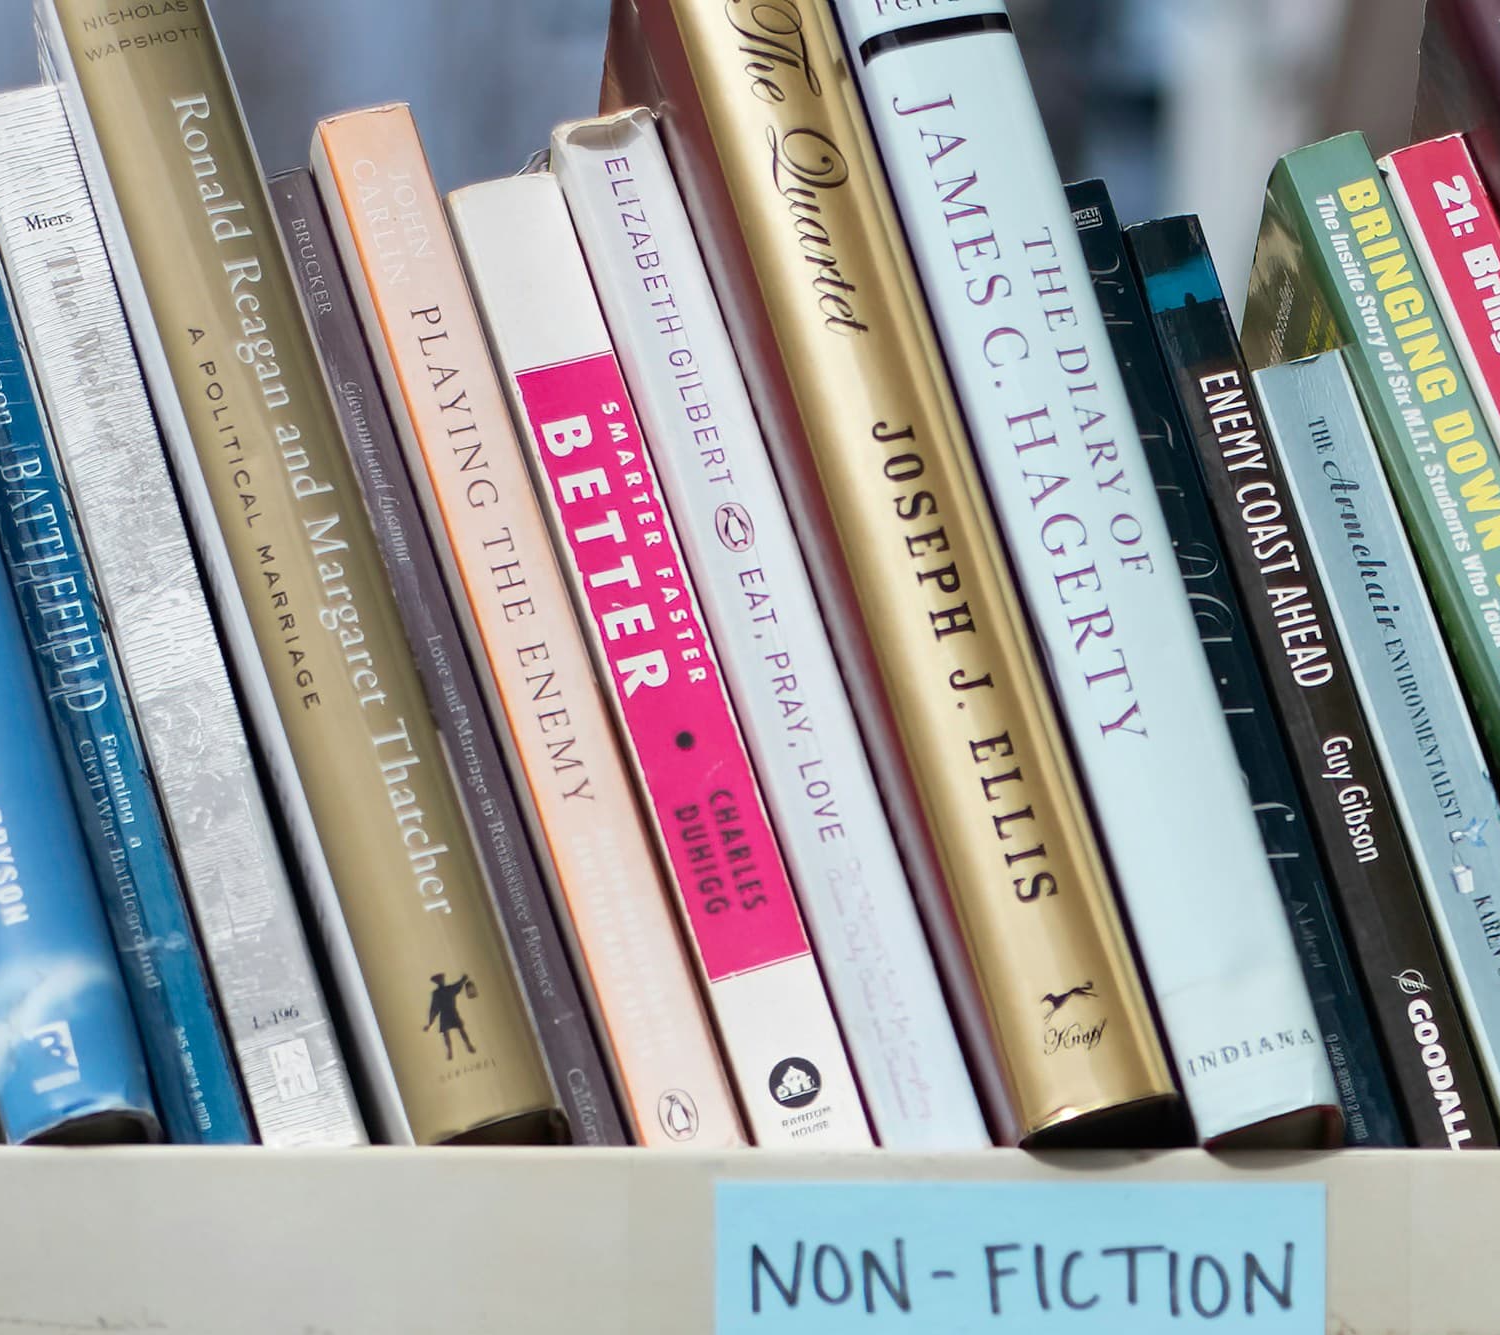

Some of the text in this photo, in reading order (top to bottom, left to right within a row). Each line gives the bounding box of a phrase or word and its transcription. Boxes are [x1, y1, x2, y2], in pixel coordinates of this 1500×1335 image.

[603, 156, 734, 485] ELIZABETH GILBERT
[766, 124, 869, 337] Quartet
[1336, 176, 1458, 403] BRINGING
[1432, 174, 1481, 238] 21:
[172, 93, 452, 915] Ronald Reagan and Margaret Thatcher
[600, 401, 707, 684] SMARTER FASTER
[892, 93, 1148, 737] JAMES C. HAGERTY
[1022, 225, 1155, 574] THE DIARY OF
[1198, 369, 1334, 688] ENEMY COAST AHEAD
[409, 304, 595, 801] PLAYING THE ENEMY
[540, 414, 670, 699] BETTER
[871, 421, 1059, 903] JOSEPH J. ELLIS
[738, 568, 845, 843] EAT, PRAY, LOVE
[1320, 735, 1380, 864] Guy Gibson
